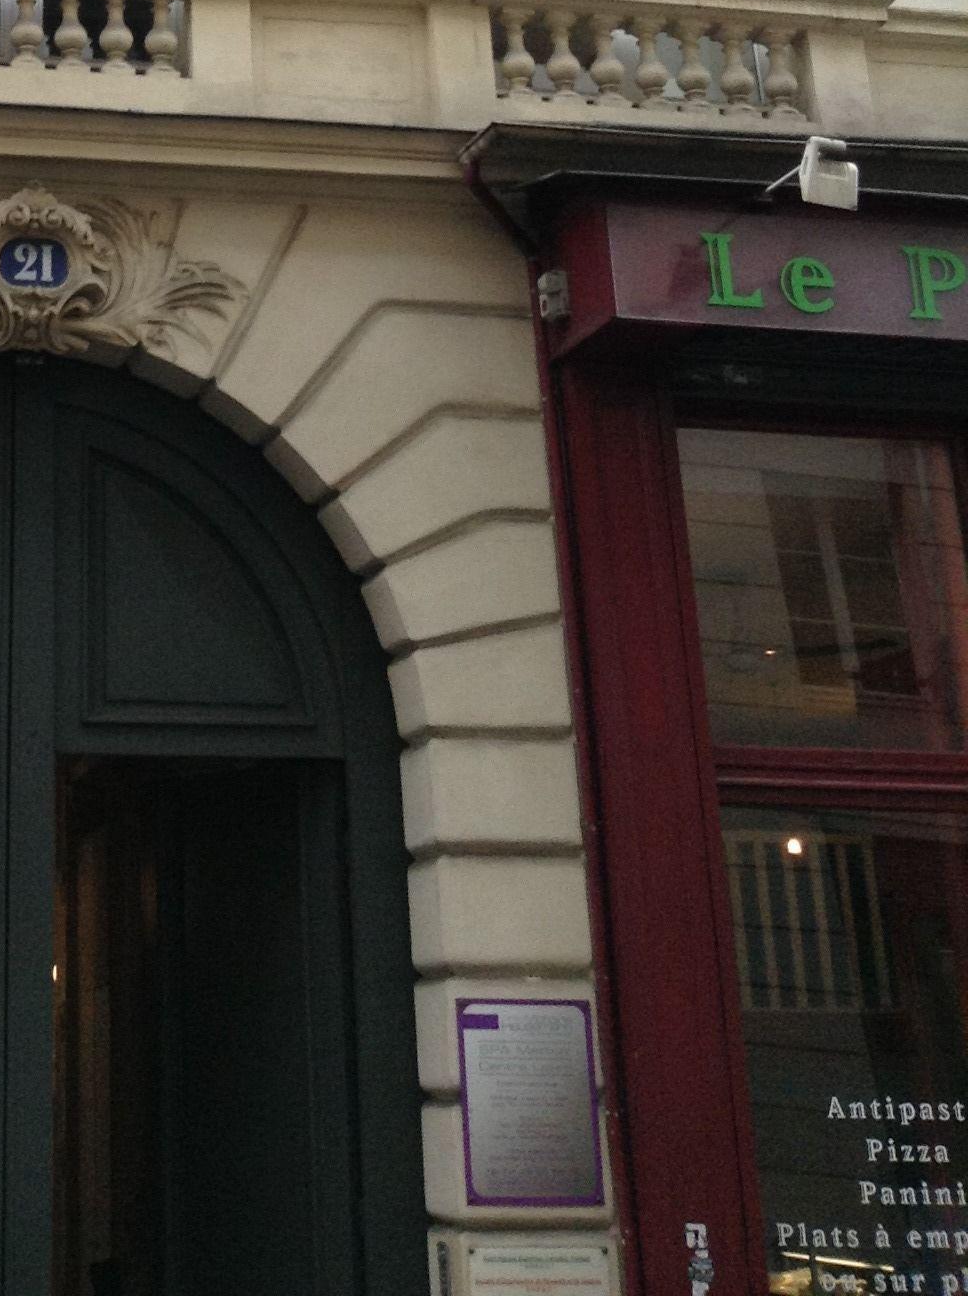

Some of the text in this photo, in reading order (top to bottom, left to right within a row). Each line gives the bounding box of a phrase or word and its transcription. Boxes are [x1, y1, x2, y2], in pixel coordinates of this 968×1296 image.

[13, 243, 54, 282] 21
[700, 231, 836, 314] Le
[866, 1137, 950, 1163] Pizza
[858, 1181, 967, 1205] Panini
[776, 1222, 860, 1248] Plats
[874, 1223, 891, 1249] à
[873, 1272, 925, 1293] sur
